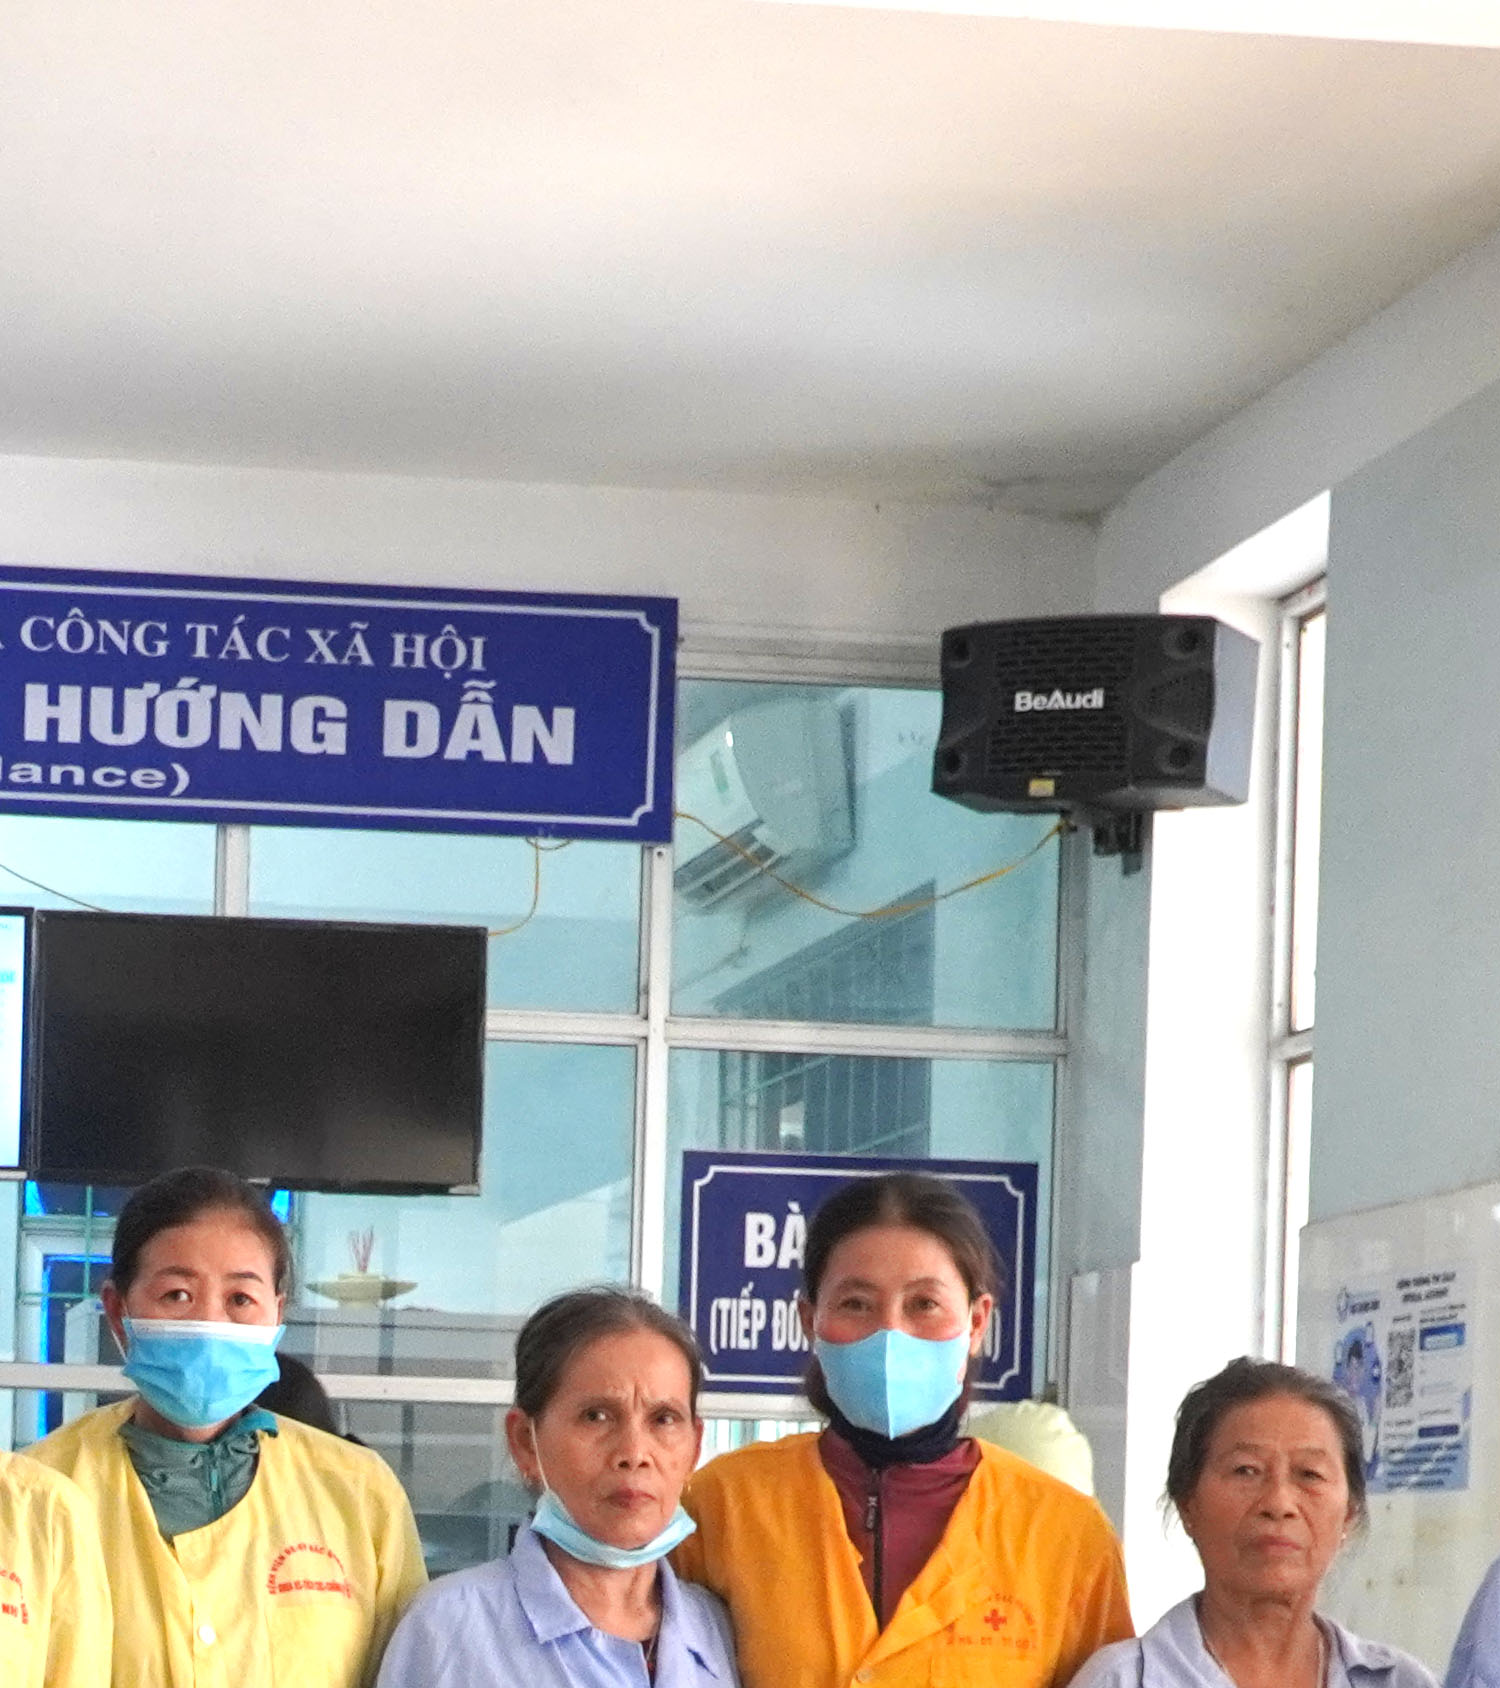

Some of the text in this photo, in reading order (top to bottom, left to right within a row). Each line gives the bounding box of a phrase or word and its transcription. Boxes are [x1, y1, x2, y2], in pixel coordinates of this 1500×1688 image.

[20, 609, 171, 661] CÔNG
[185, 618, 290, 663] TÁC
[305, 623, 373, 668] XÃ
[391, 625, 486, 680] HỘI
[24, 676, 349, 757] HƯỚNG
[382, 680, 576, 766] DẪN
[1014, 687, 1104, 713] BeAudi
[744, 1201, 806, 1269] BÀ
[710, 1281, 808, 1355] (TIẾP ĐÓ
